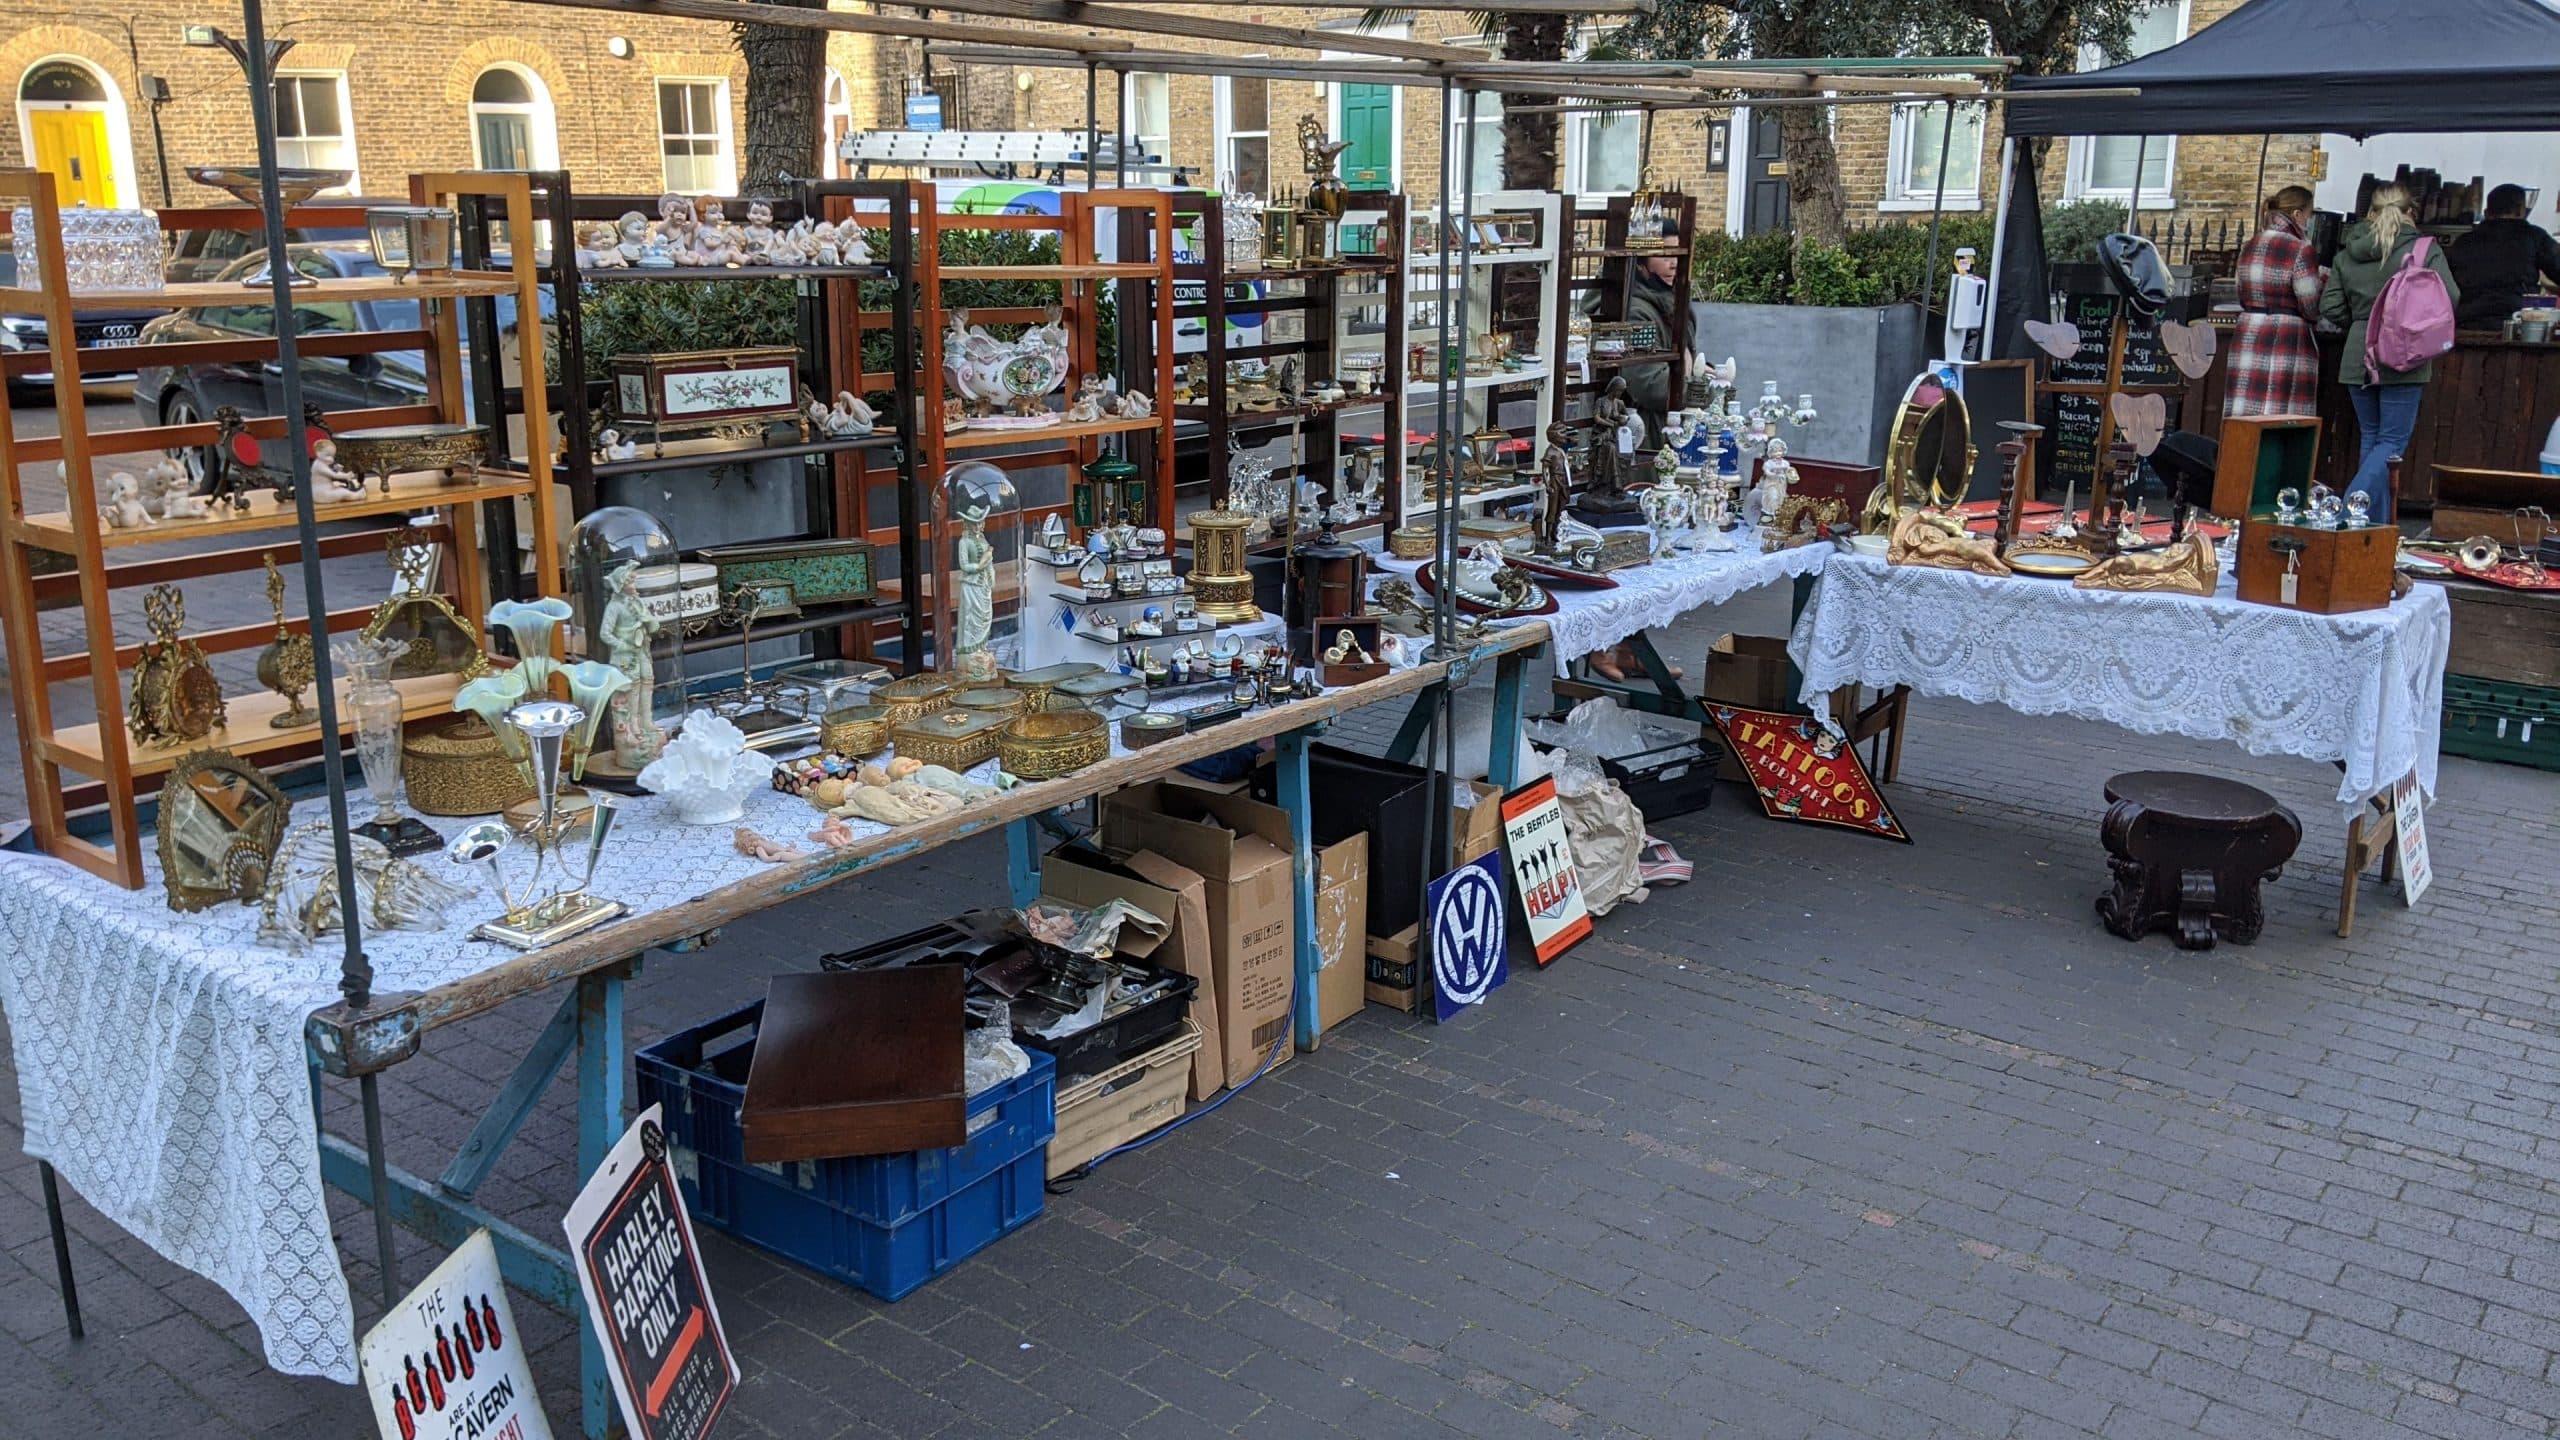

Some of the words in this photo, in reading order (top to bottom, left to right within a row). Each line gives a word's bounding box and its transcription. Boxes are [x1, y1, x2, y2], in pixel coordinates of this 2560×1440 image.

[2080, 298, 2112, 318] Food
[1739, 720, 1870, 819] TATTOOS
[1758, 755, 1800, 787] BODY
[1800, 783, 1833, 808] ART
[1509, 826, 1525, 843] THE
[1526, 807, 1560, 834] BEATLES
[1524, 864, 1578, 919] HELP!
[604, 1181, 664, 1293] HARLEY
[613, 1218, 681, 1342] PARKING
[418, 1287, 445, 1328] THE
[641, 1274, 681, 1359] ONLY
[392, 1293, 503, 1440] BEATLES
[664, 1396, 678, 1423] ALL
[679, 1353, 700, 1396] OTHER
[449, 1403, 465, 1429] ARE
[466, 1390, 475, 1410] AT
[665, 1409, 687, 1440] IKES
[681, 1391, 715, 1440] RUSHED.
